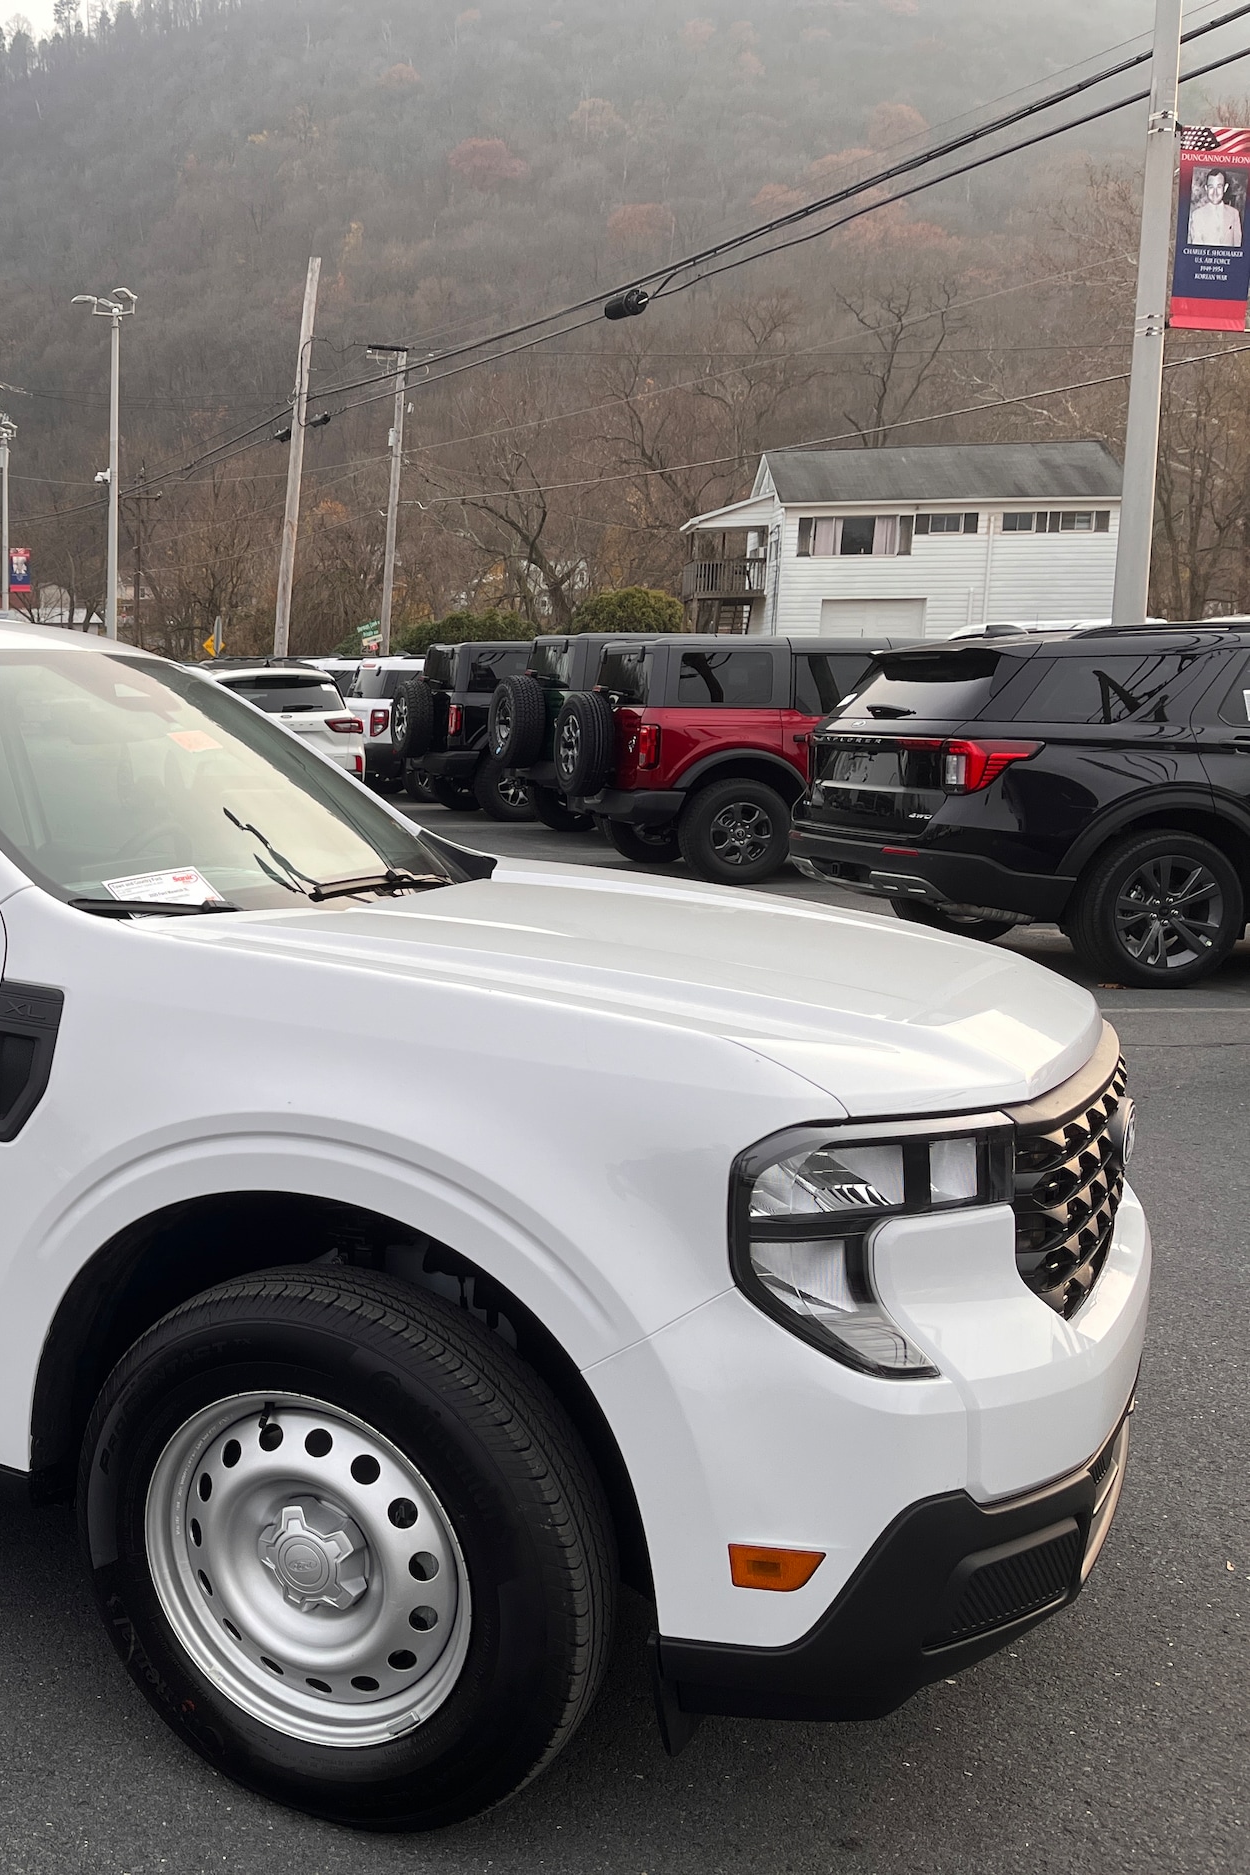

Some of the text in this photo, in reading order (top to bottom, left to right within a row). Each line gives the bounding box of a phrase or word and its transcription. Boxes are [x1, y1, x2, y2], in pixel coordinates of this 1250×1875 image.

[1181, 153, 1250, 164] DUNCANNON HON
[908, 812, 933, 820] 4WD
[172, 873, 194, 883] Sonic
[5, 1000, 46, 1020] XL
